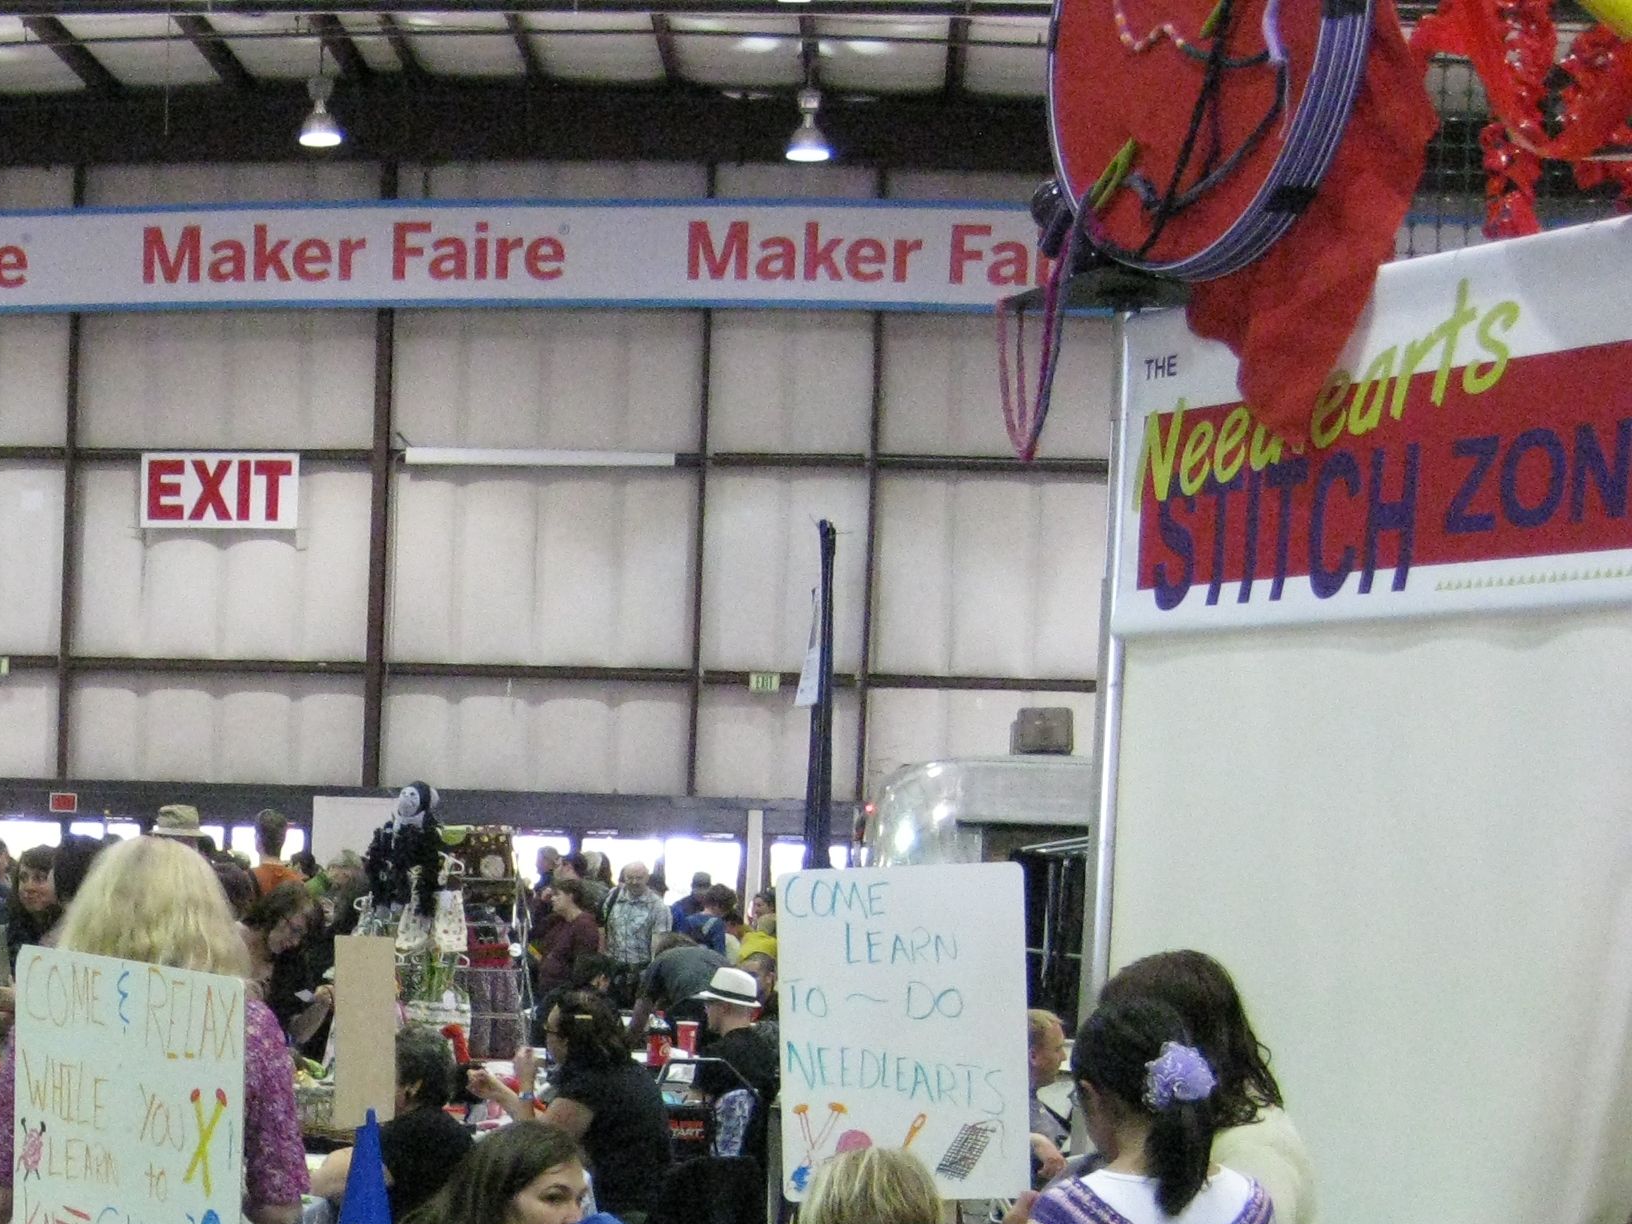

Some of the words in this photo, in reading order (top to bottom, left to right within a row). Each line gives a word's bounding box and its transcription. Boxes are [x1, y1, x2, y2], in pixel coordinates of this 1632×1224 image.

[141, 223, 367, 284] Maker
[391, 221, 566, 281] Faire
[687, 219, 922, 284] Maker
[948, 223, 1051, 286] Fai
[1144, 354, 1178, 381] THE
[147, 458, 292, 522] EXIT
[1152, 442, 1423, 612] STITCH
[1445, 417, 1632, 535] ZON
[784, 875, 890, 920] COME
[845, 922, 959, 965] LEARN
[24, 955, 106, 1028] COME
[145, 966, 238, 1061] RELAX
[783, 978, 829, 1019] TO
[905, 981, 965, 1021] DO
[22, 1048, 109, 1131] WHILE
[138, 1082, 186, 1152] YOU
[786, 1040, 1006, 1116] NEEDLEARTS
[47, 1136, 120, 1187] LEARN
